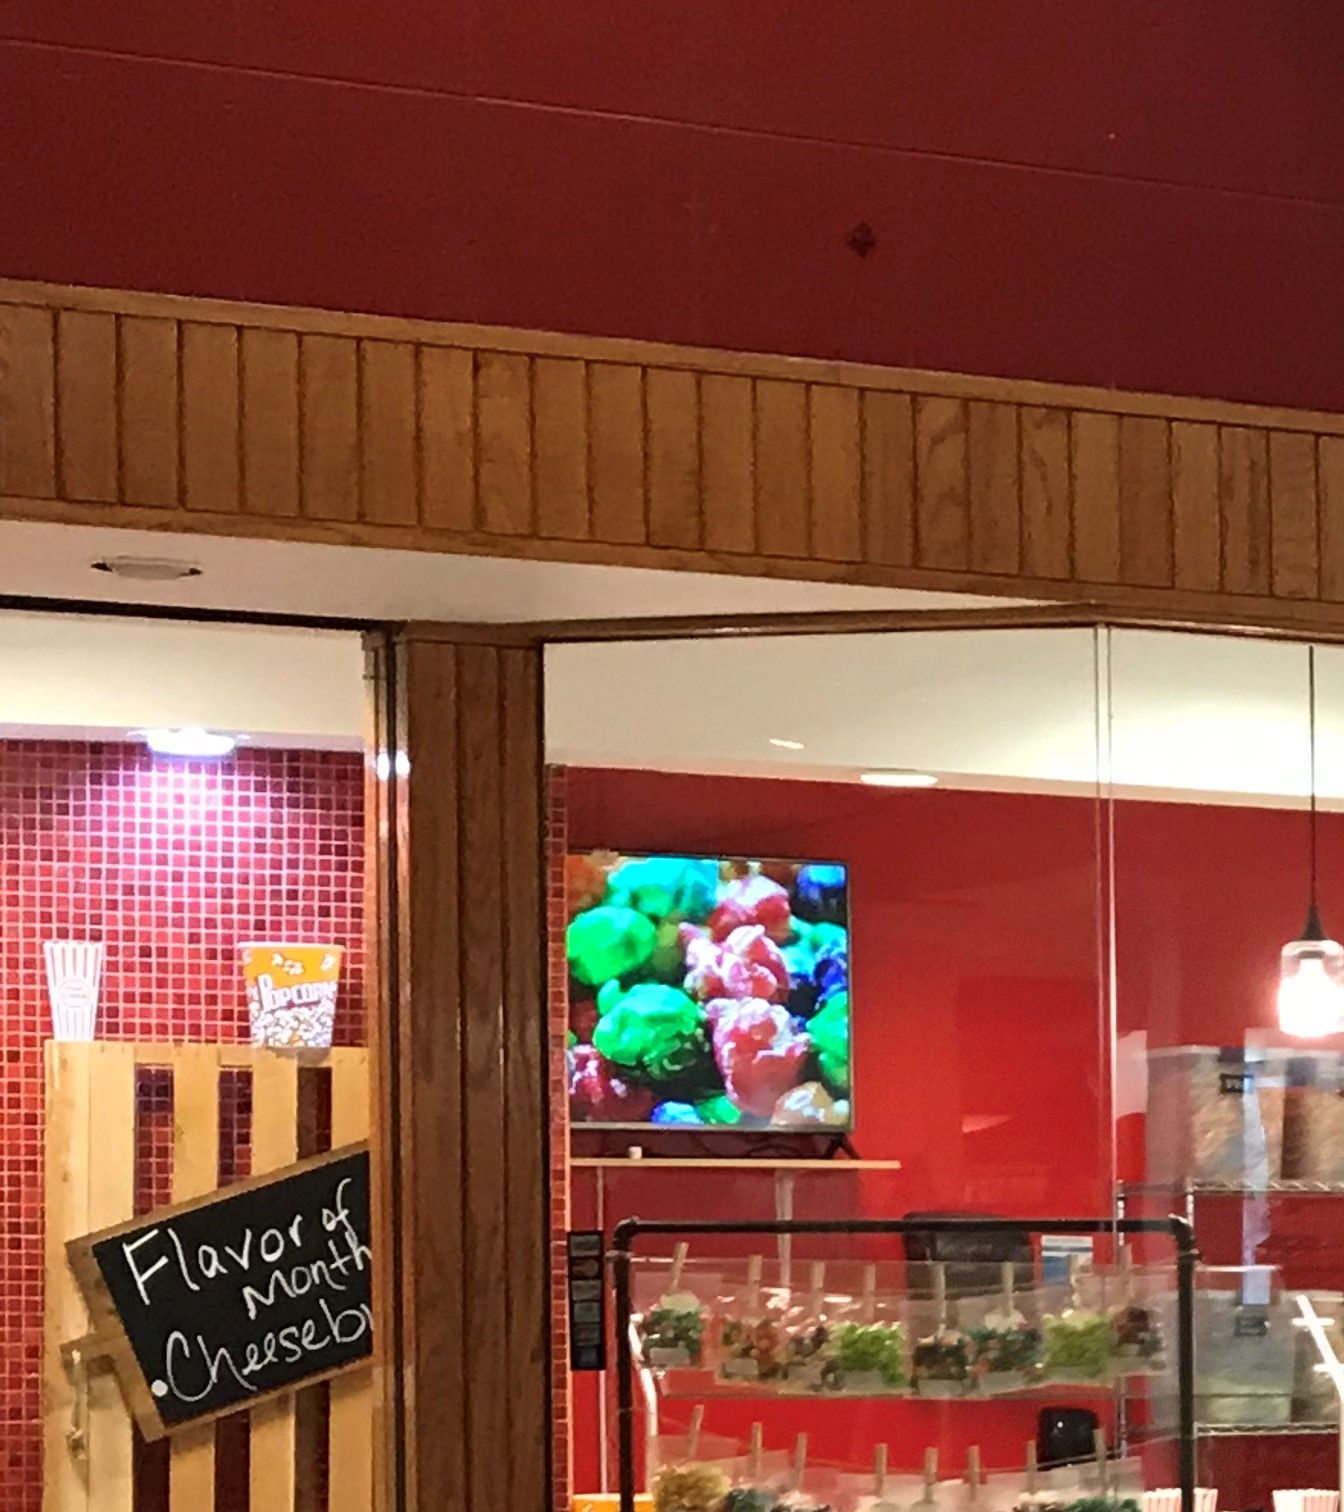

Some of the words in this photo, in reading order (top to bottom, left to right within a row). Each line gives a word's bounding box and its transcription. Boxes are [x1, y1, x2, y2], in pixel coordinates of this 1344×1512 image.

[122, 1214, 303, 1305] Flavor
[322, 1178, 352, 1234] of
[242, 1231, 373, 1320] Month
